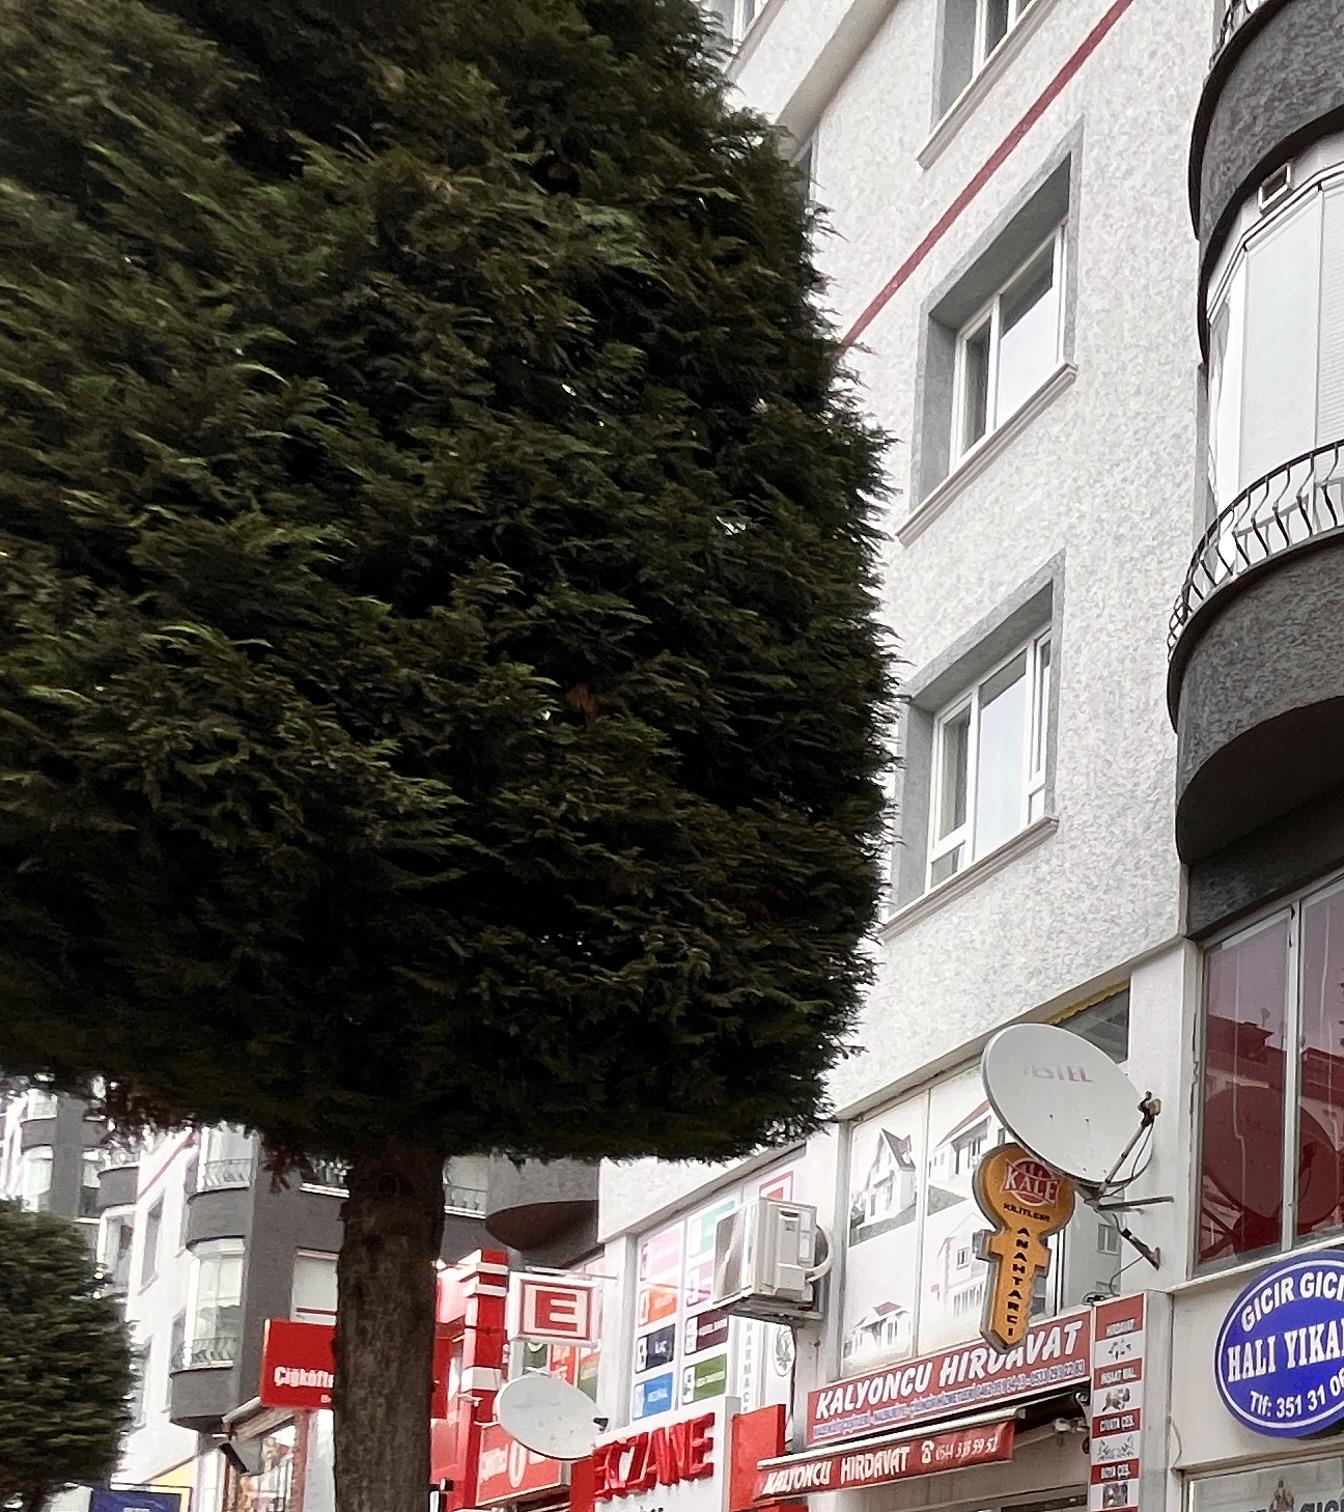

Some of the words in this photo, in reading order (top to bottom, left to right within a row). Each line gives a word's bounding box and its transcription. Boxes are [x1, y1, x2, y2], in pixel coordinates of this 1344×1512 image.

[1003, 1163, 1060, 1204] KALE
[535, 1289, 578, 1332] E
[1241, 1276, 1295, 1332] GICIR
[1227, 1335, 1276, 1383] HALI
[816, 1362, 933, 1420] KALYONCU
[1276, 1394, 1302, 1419] 351
[1308, 1384, 1326, 1411] 31
[592, 1412, 716, 1501] ECZANE
[762, 1460, 832, 1495] KALYONCU
[840, 1446, 911, 1485] HIRDAVAT
